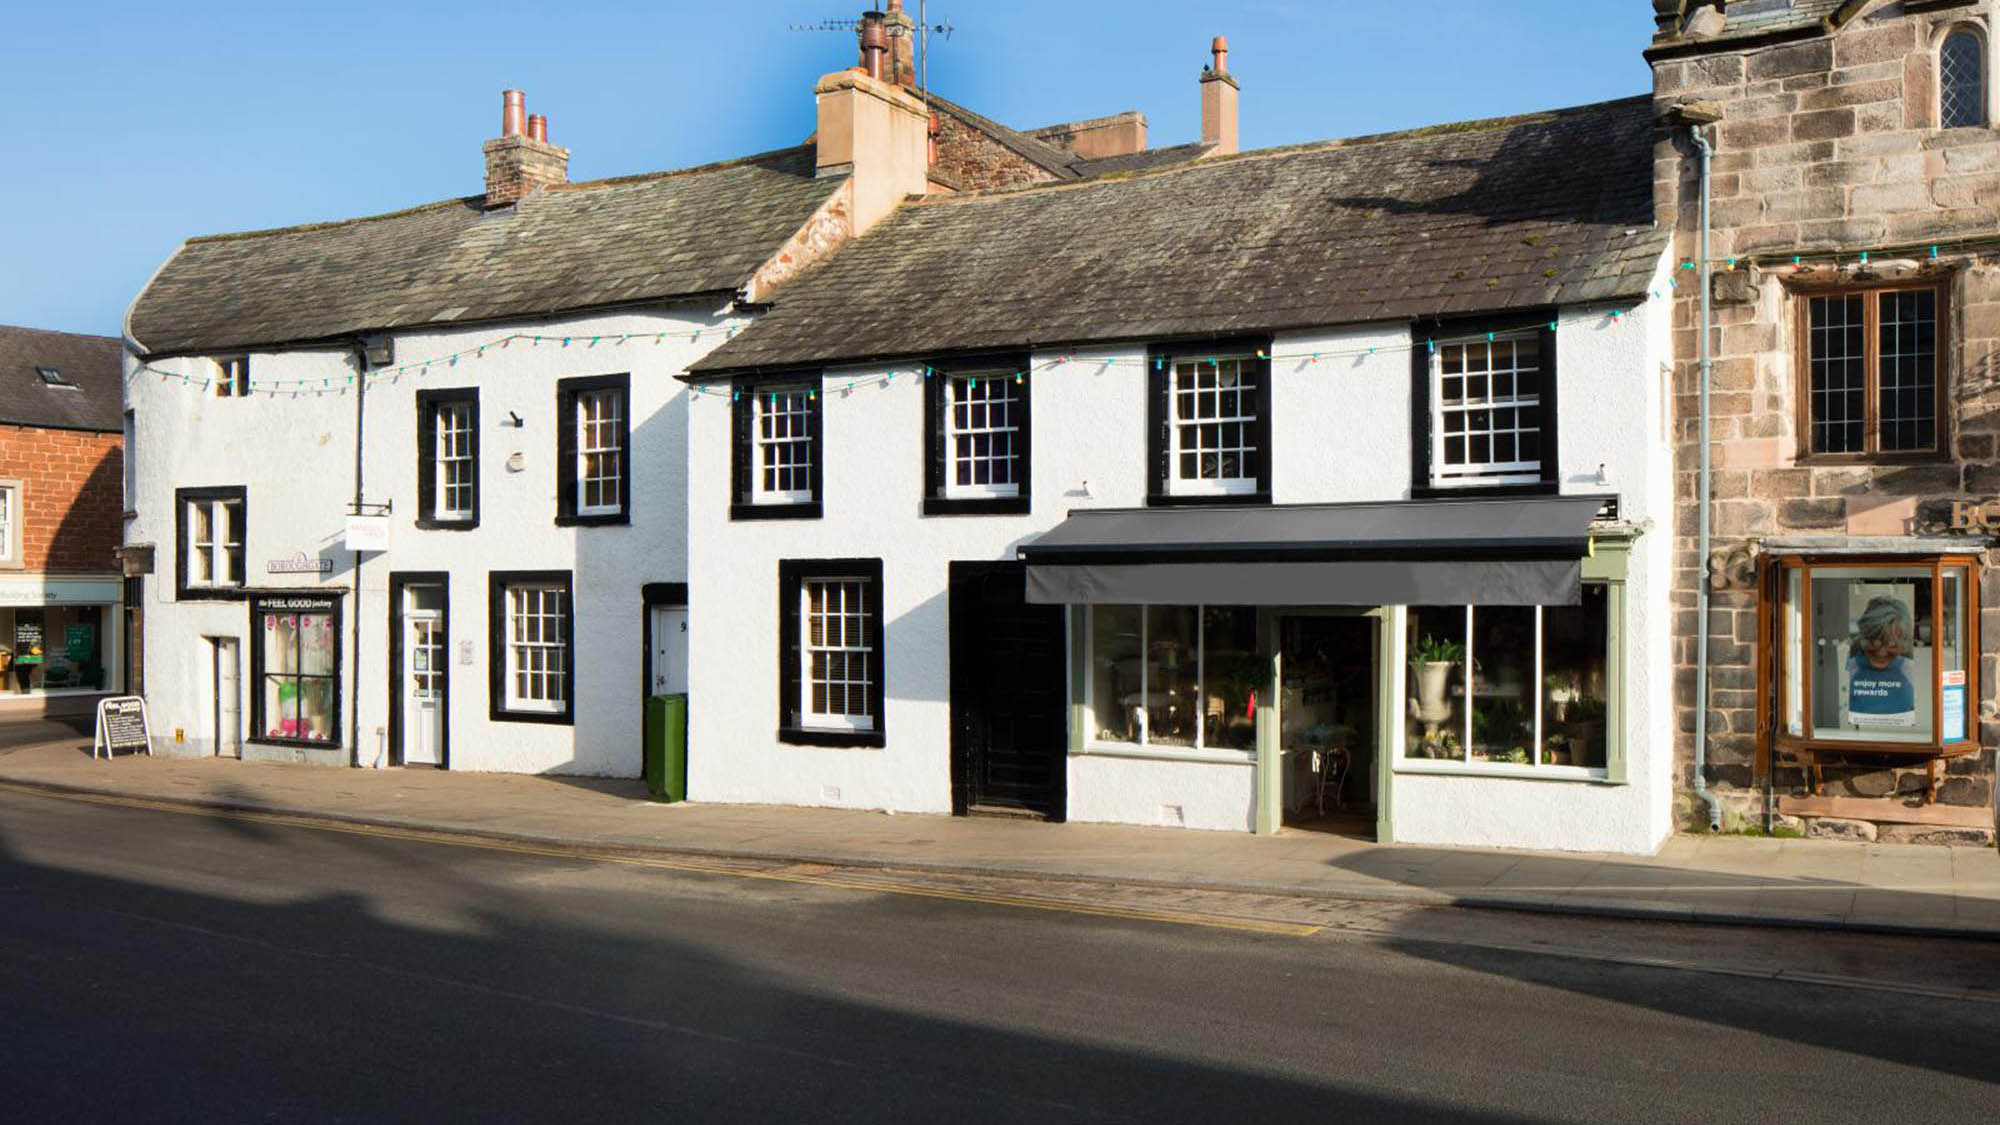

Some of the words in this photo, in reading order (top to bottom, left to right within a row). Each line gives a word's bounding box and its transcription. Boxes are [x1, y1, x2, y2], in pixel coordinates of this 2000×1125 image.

[268, 599, 287, 608] FEEL
[288, 599, 312, 608] GOOD
[1853, 679, 1877, 689] enjoy
[1853, 689, 1888, 697] rewards
